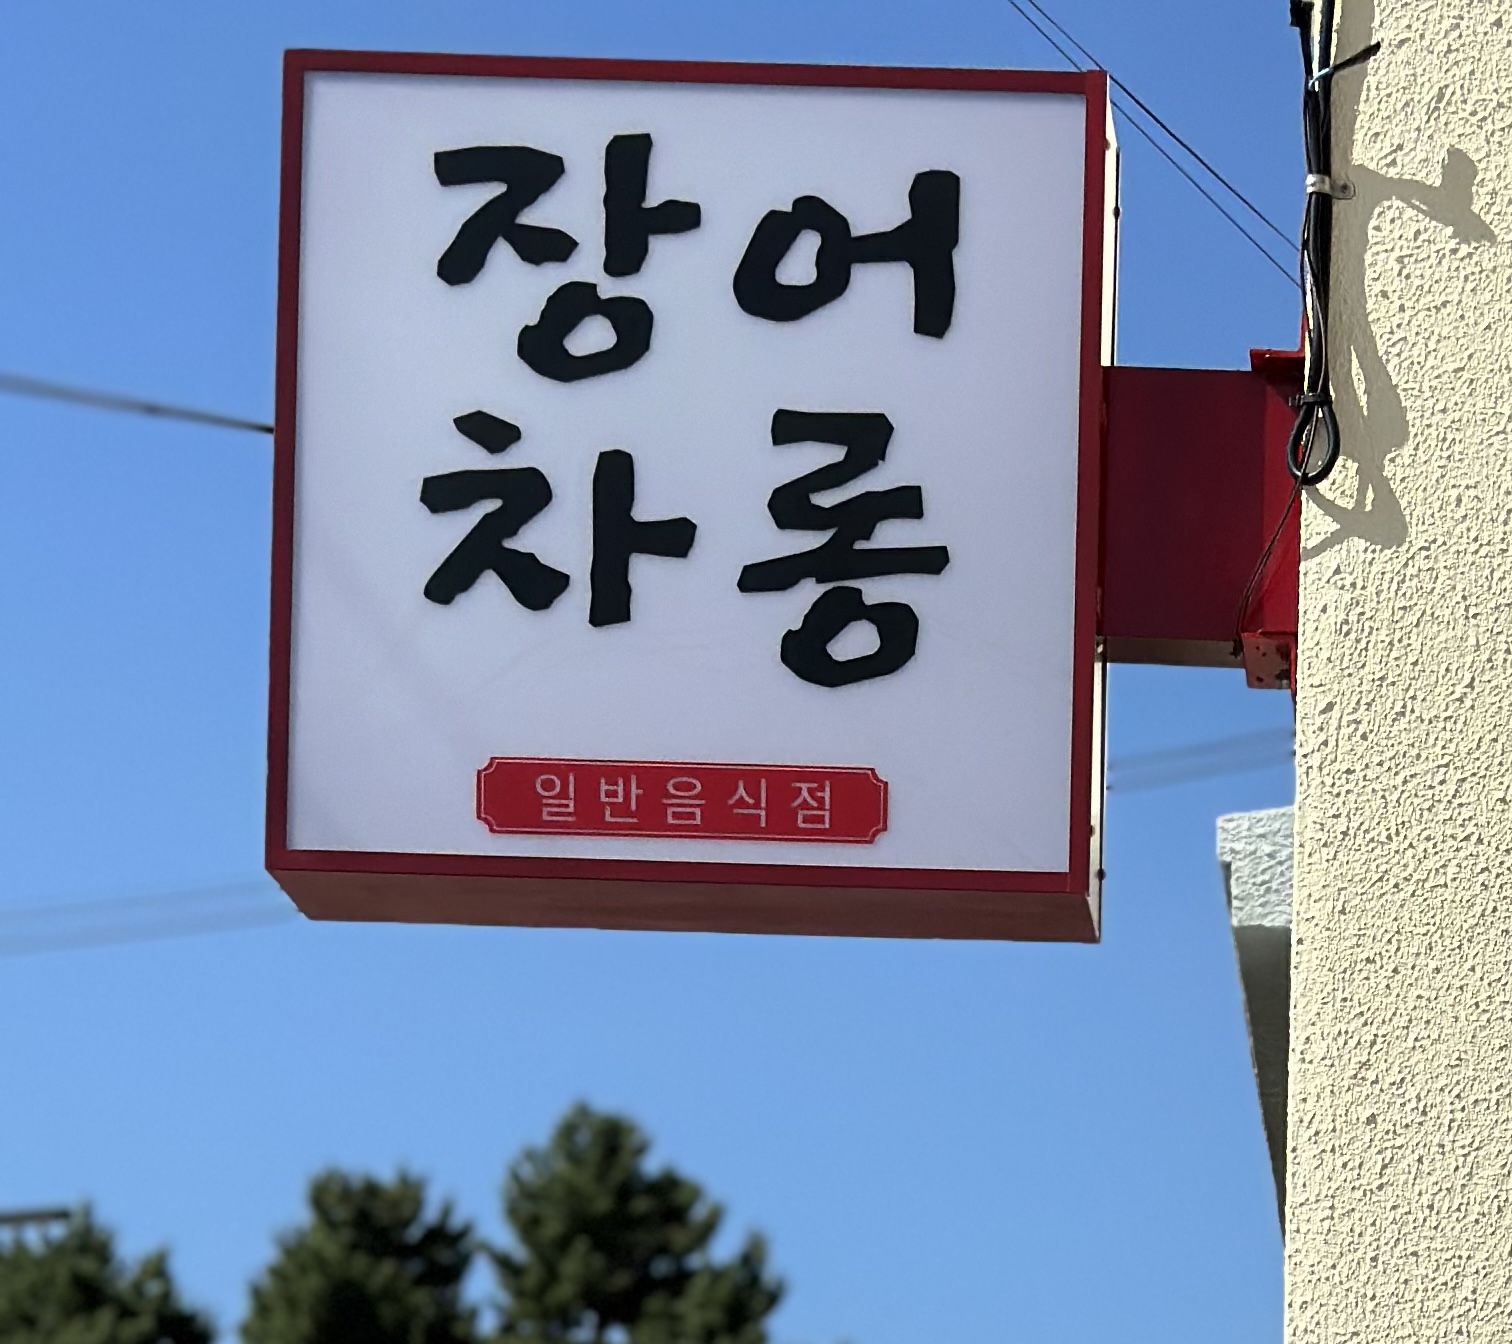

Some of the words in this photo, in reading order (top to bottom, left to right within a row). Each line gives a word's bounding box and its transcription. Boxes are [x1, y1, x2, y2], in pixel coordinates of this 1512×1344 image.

[433, 132, 961, 384] 장어
[419, 408, 951, 689] 차롱
[534, 773, 833, 831] 일반음식점
